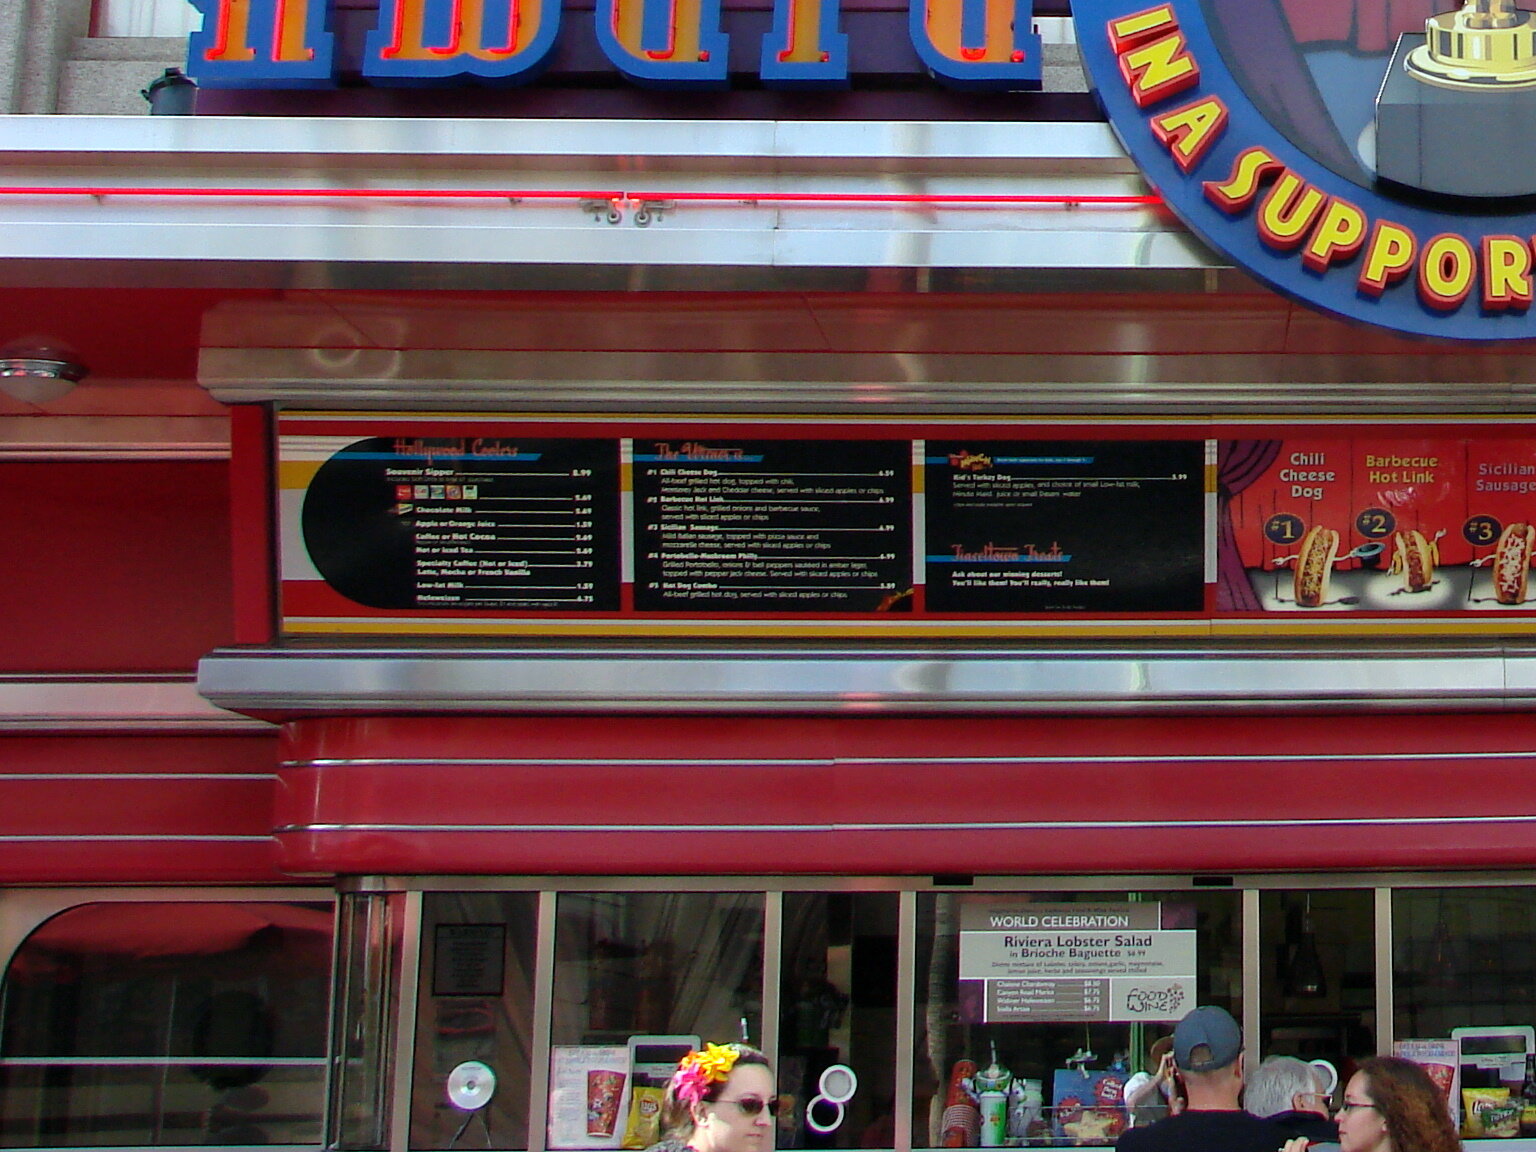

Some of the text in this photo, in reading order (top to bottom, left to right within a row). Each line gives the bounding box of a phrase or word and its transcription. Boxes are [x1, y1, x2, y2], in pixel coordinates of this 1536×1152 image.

[1107, 3, 1201, 107] IN
[1151, 93, 1229, 175] A
[1290, 452, 1325, 465] Chili
[1366, 455, 1438, 467] Barbecue
[1279, 469, 1335, 482] Cheese
[1478, 463, 1536, 476] Sicilian
[1369, 470, 1435, 484] Hot Link
[1291, 484, 1324, 500] Dog
[1271, 519, 1296, 540] #1
[1361, 514, 1387, 533] #2
[1468, 521, 1493, 540] #3
[990, 915, 1129, 928] WORLD CELEBRATION
[1004, 935, 1153, 948] Riviera Lobster Salad
[1021, 948, 1065, 958] Brioche
[1069, 948, 1121, 960] Baguette
[1128, 987, 1168, 1001] FOOD
[1127, 999, 1168, 1013] WINE
